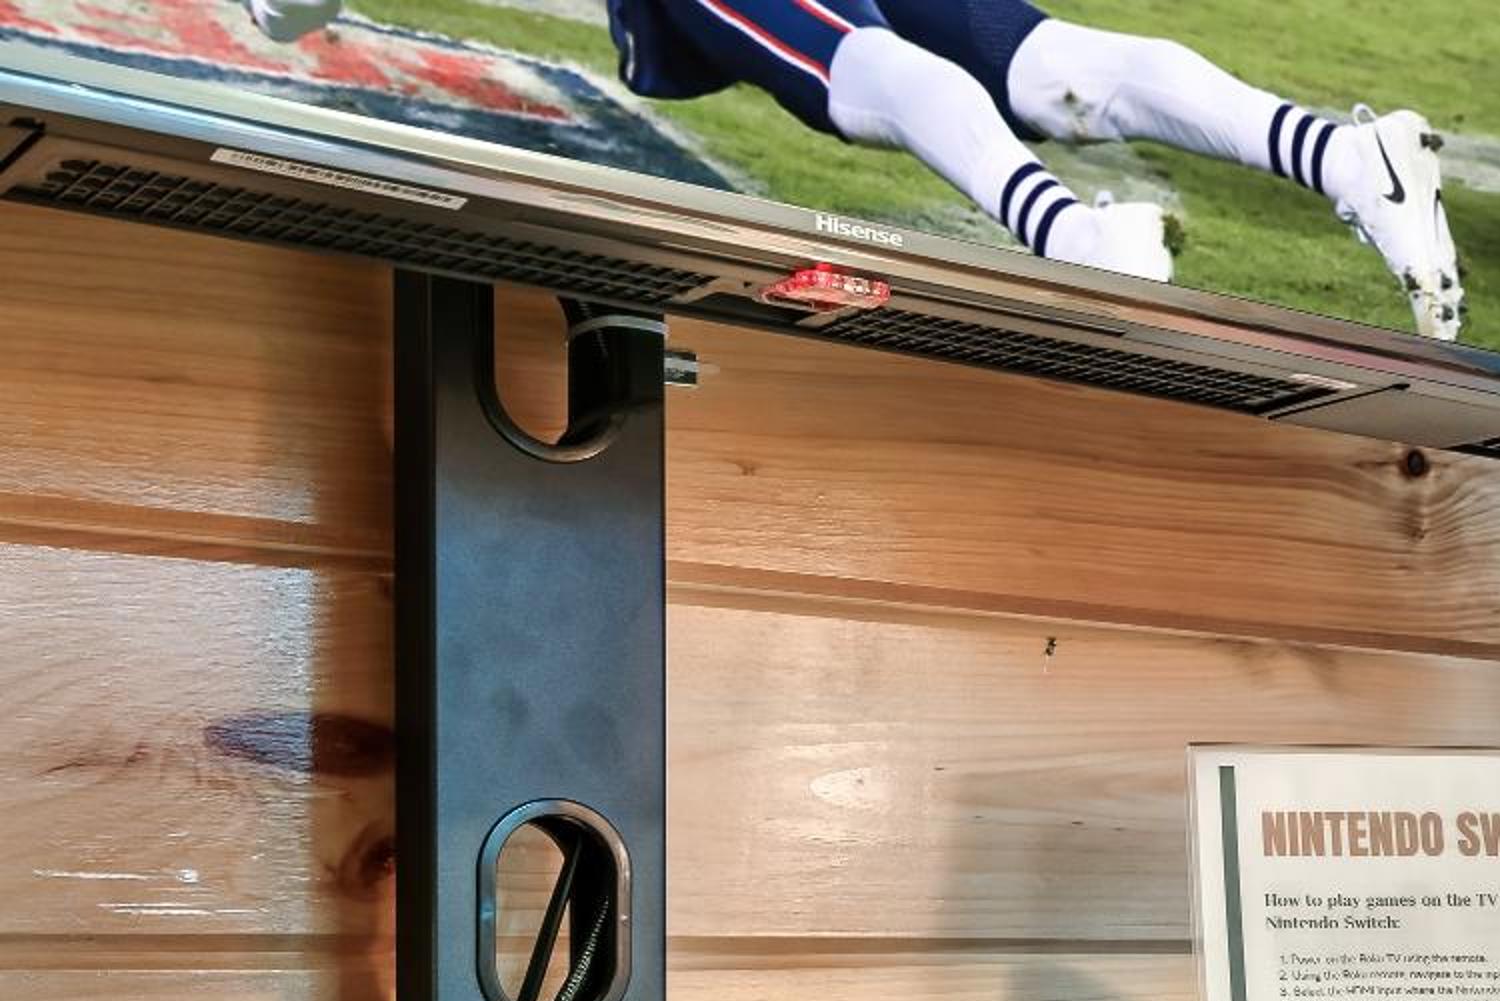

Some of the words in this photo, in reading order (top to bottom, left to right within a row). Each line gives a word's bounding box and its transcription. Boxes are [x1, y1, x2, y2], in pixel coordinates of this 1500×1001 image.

[815, 213, 904, 248] Hisense
[1261, 811, 1446, 858] NINTENDO
[1264, 893, 1300, 908] How
[1305, 893, 1324, 908] to
[1328, 893, 1361, 910] play
[1366, 894, 1417, 910] games
[1421, 894, 1442, 908] on
[1447, 892, 1472, 908] the
[1476, 893, 1500, 908] TV
[1265, 915, 1339, 930] Nintendo
[1344, 914, 1402, 930] Switch:
